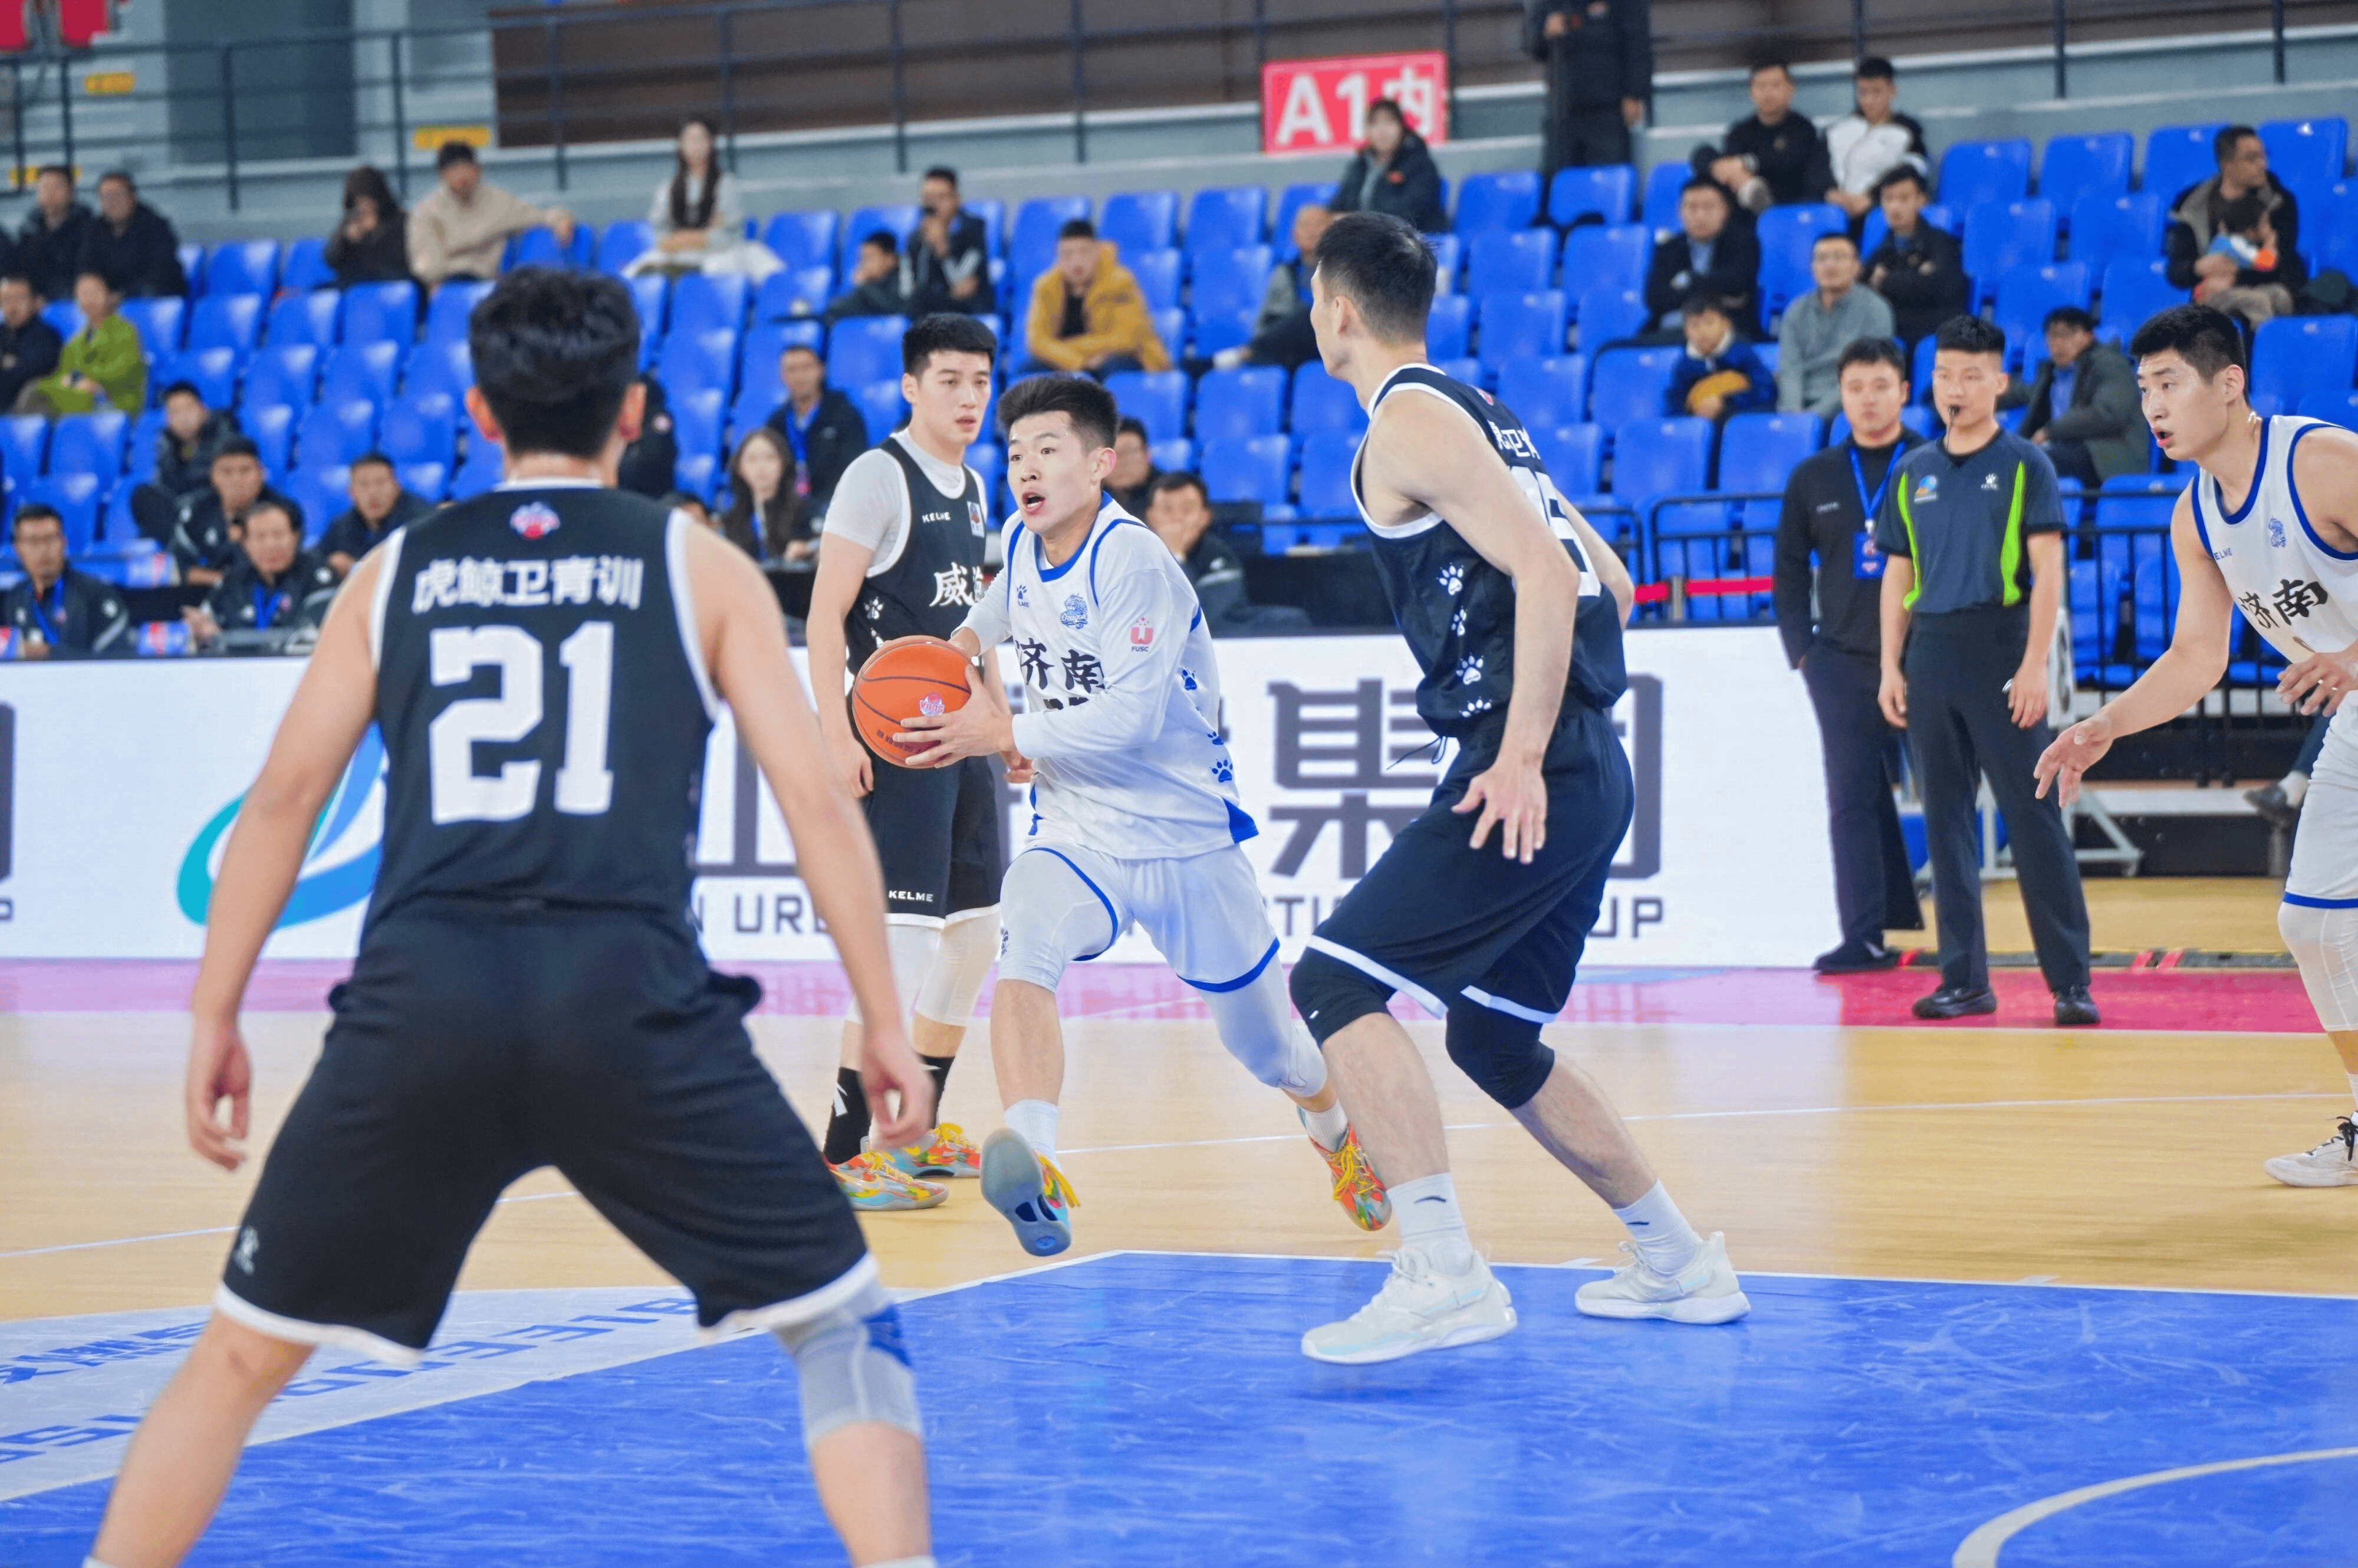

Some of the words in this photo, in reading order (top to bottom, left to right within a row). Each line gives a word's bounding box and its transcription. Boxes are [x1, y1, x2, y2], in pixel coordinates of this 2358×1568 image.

[2214, 548, 2233, 561] ELME
[429, 621, 615, 825] 21
[888, 890, 934, 902] KELME
